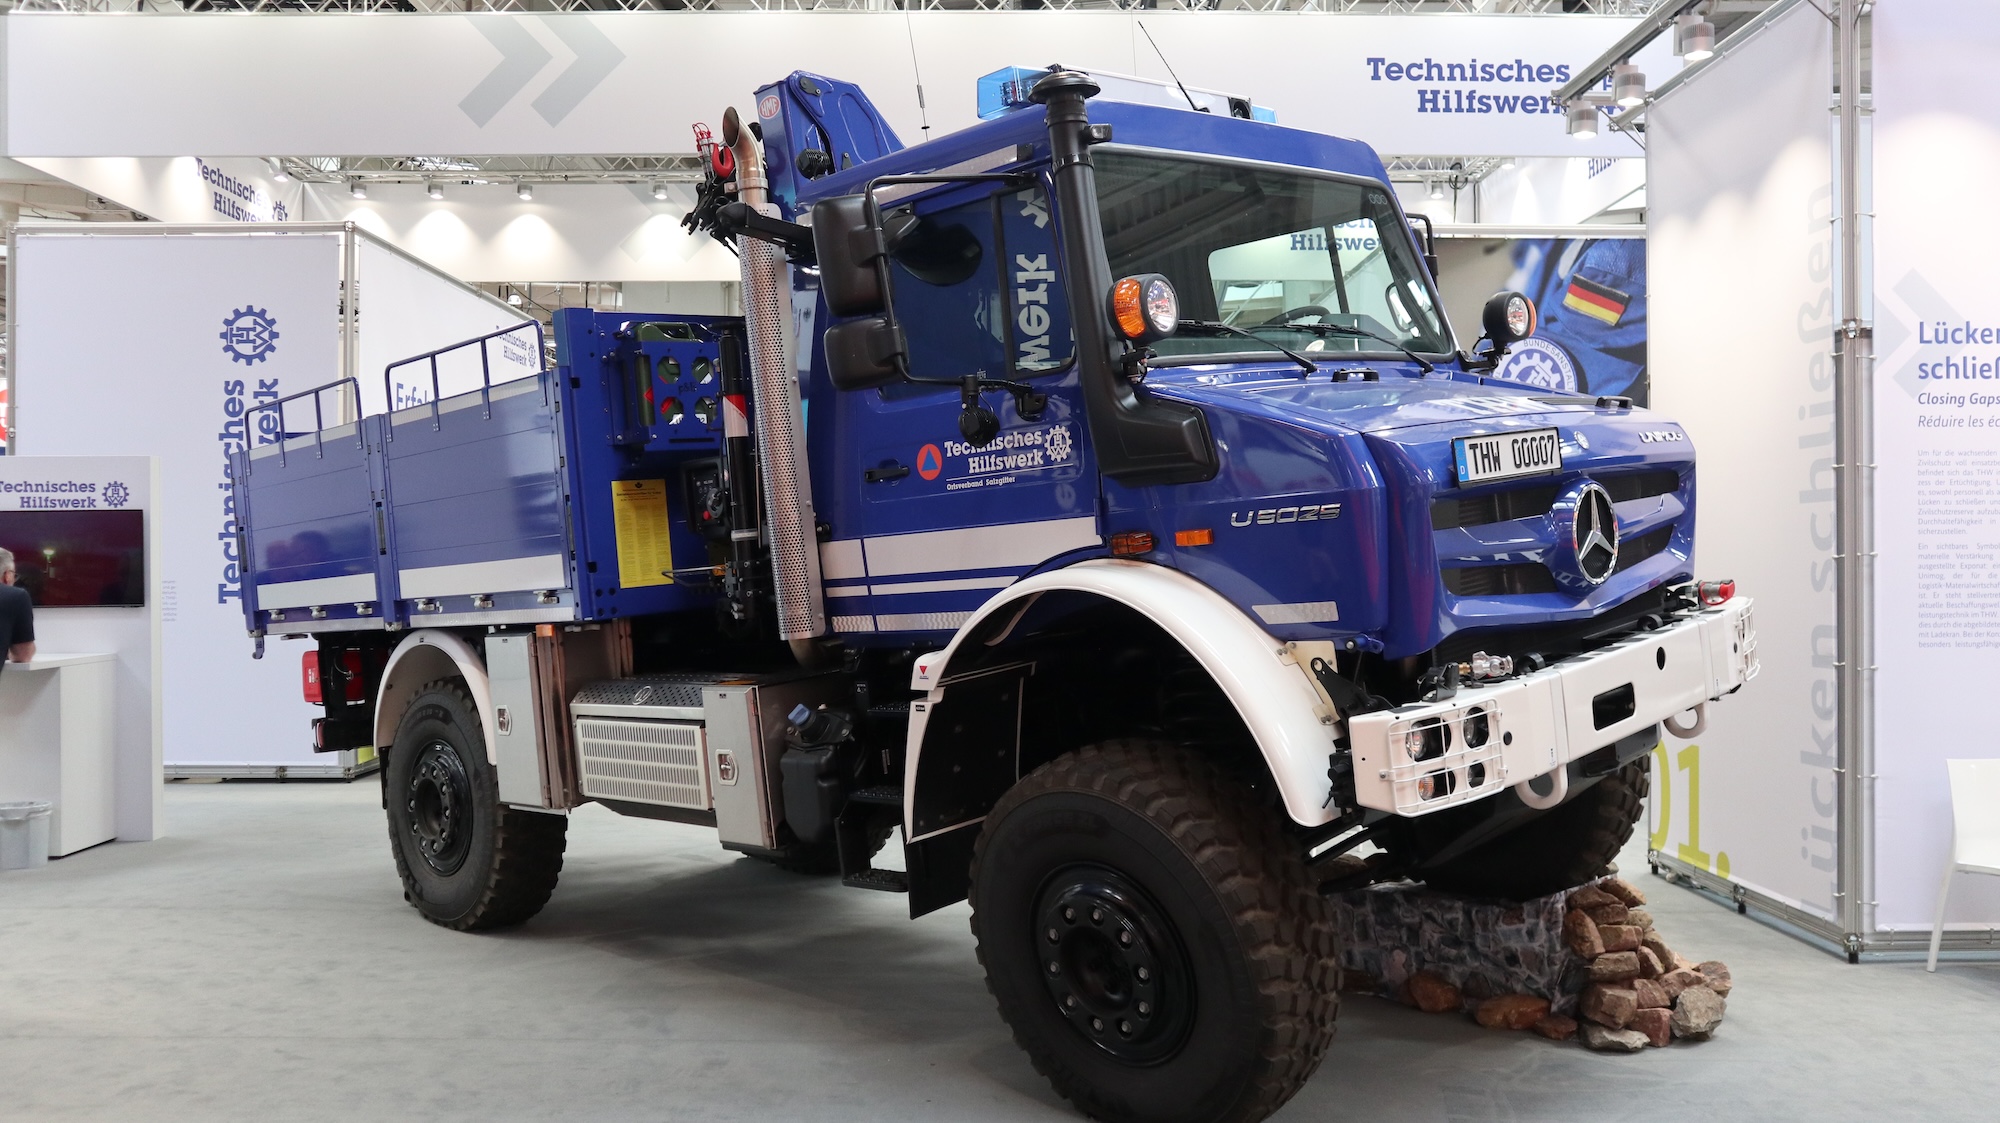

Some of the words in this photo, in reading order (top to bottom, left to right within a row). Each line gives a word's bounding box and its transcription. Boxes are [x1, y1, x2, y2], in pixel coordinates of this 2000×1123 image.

[1366, 57, 1571, 83] Technisches
[761, 97, 778, 117] HMF
[1417, 89, 1563, 114] Hilfswer
[195, 157, 268, 209] Technische
[1919, 321, 2000, 344] Lücke
[1523, 339, 1575, 391] BUNDESANSTALT
[1918, 392, 1965, 407] Closing
[1969, 392, 2000, 407] Gaps
[1918, 415, 1964, 427] Réduire
[1968, 415, 1984, 427] les
[968, 449, 1043, 474] Hilfswerk
[1460, 466, 1465, 475] D
[1469, 440, 1501, 475] THW
[1511, 434, 1555, 469] 00007
[946, 480, 983, 490] Ortsverband
[986, 476, 1015, 486] Salzgitter
[20, 496, 97, 508] Hilfswerk
